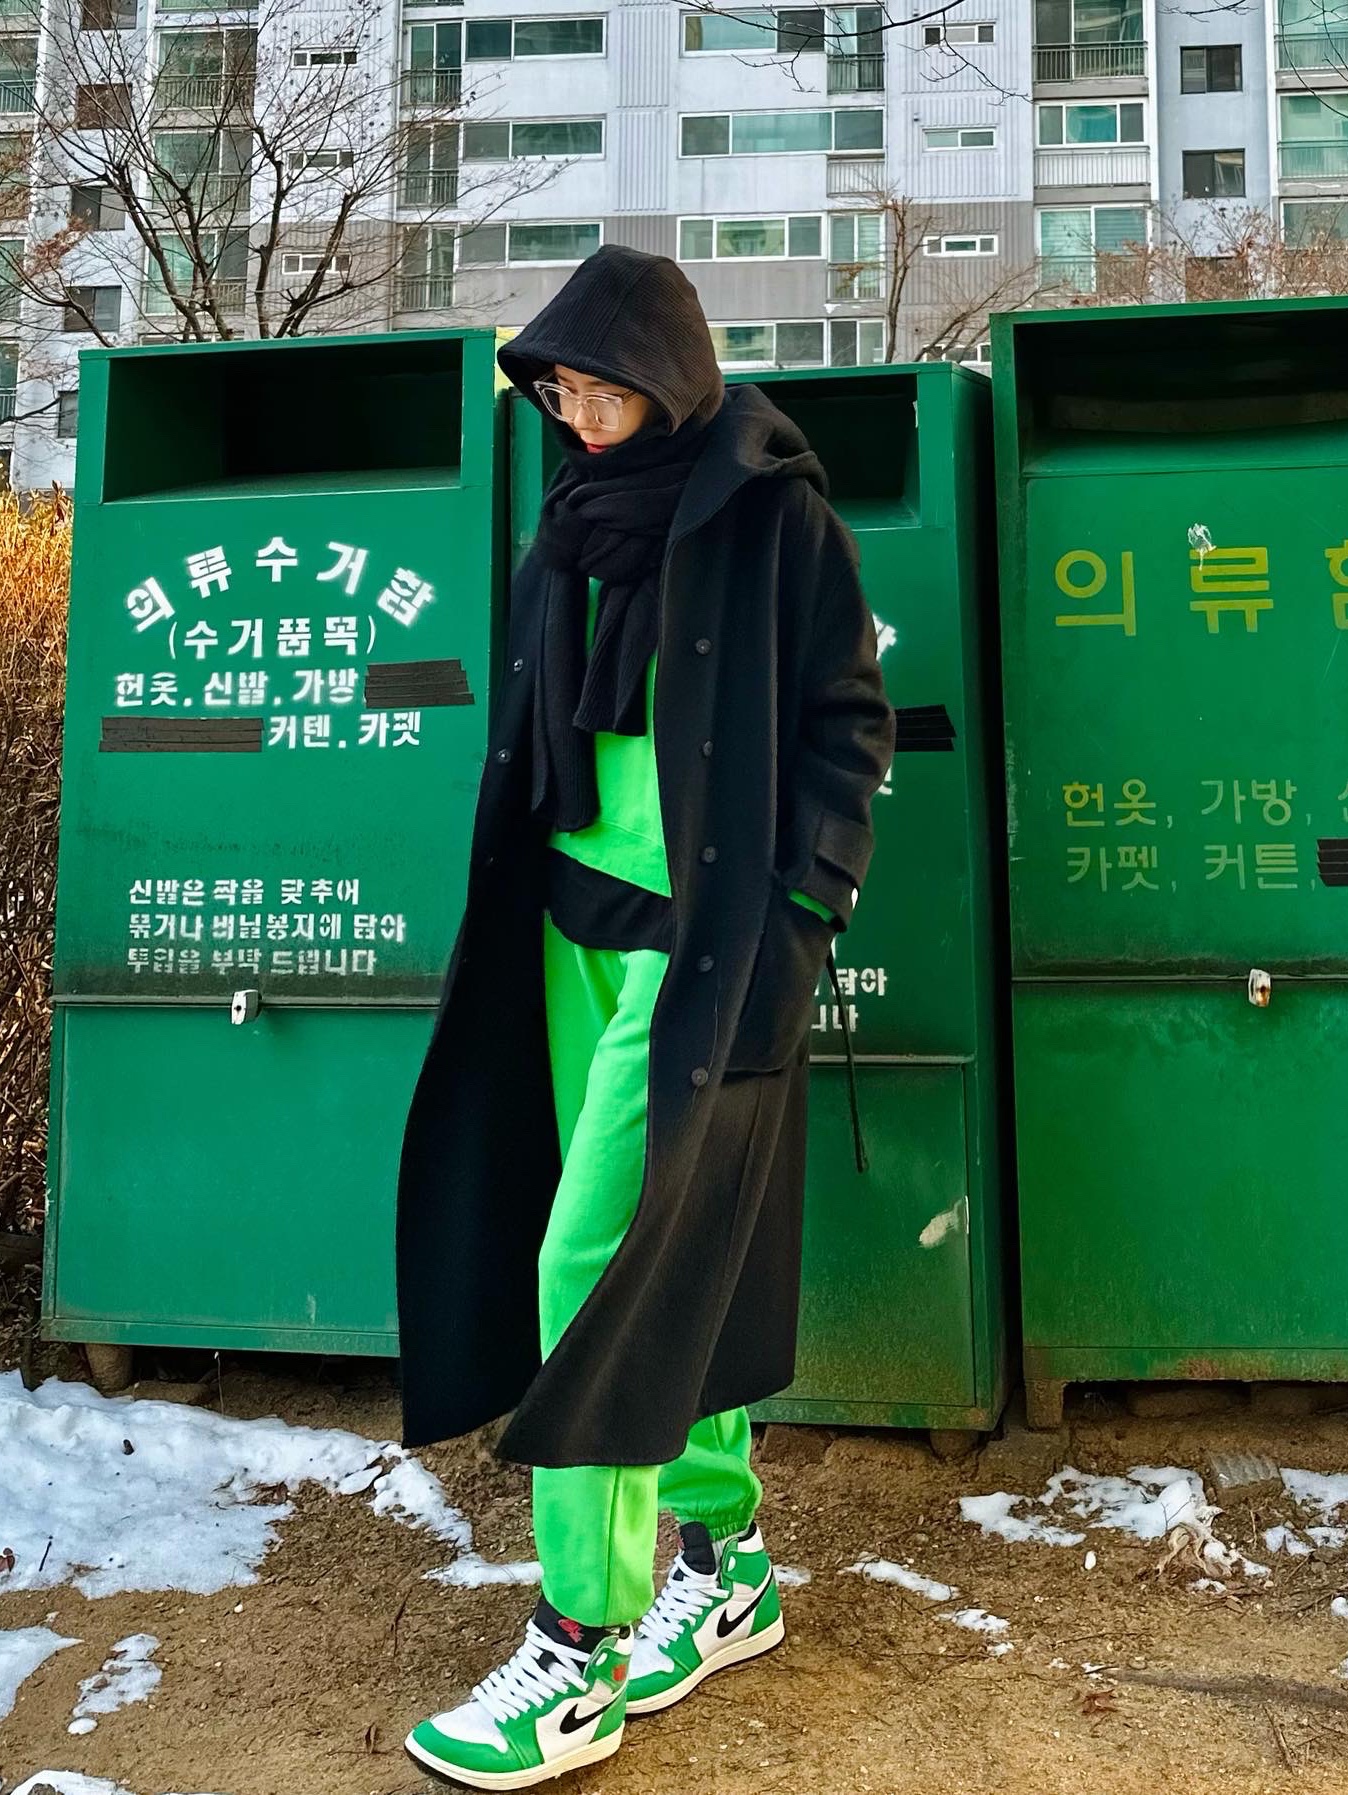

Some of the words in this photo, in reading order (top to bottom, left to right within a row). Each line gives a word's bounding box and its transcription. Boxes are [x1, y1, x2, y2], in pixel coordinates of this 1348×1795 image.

[358, 711, 421, 747] 카펫
[129, 878, 205, 906] 신발은
[212, 878, 264, 906] 짝을
[128, 913, 204, 942] 묶거나
[353, 912, 406, 943] 담아
[127, 947, 201, 975] 투입을
[211, 948, 263, 976] 부탁
[270, 949, 377, 977] 드립니다
